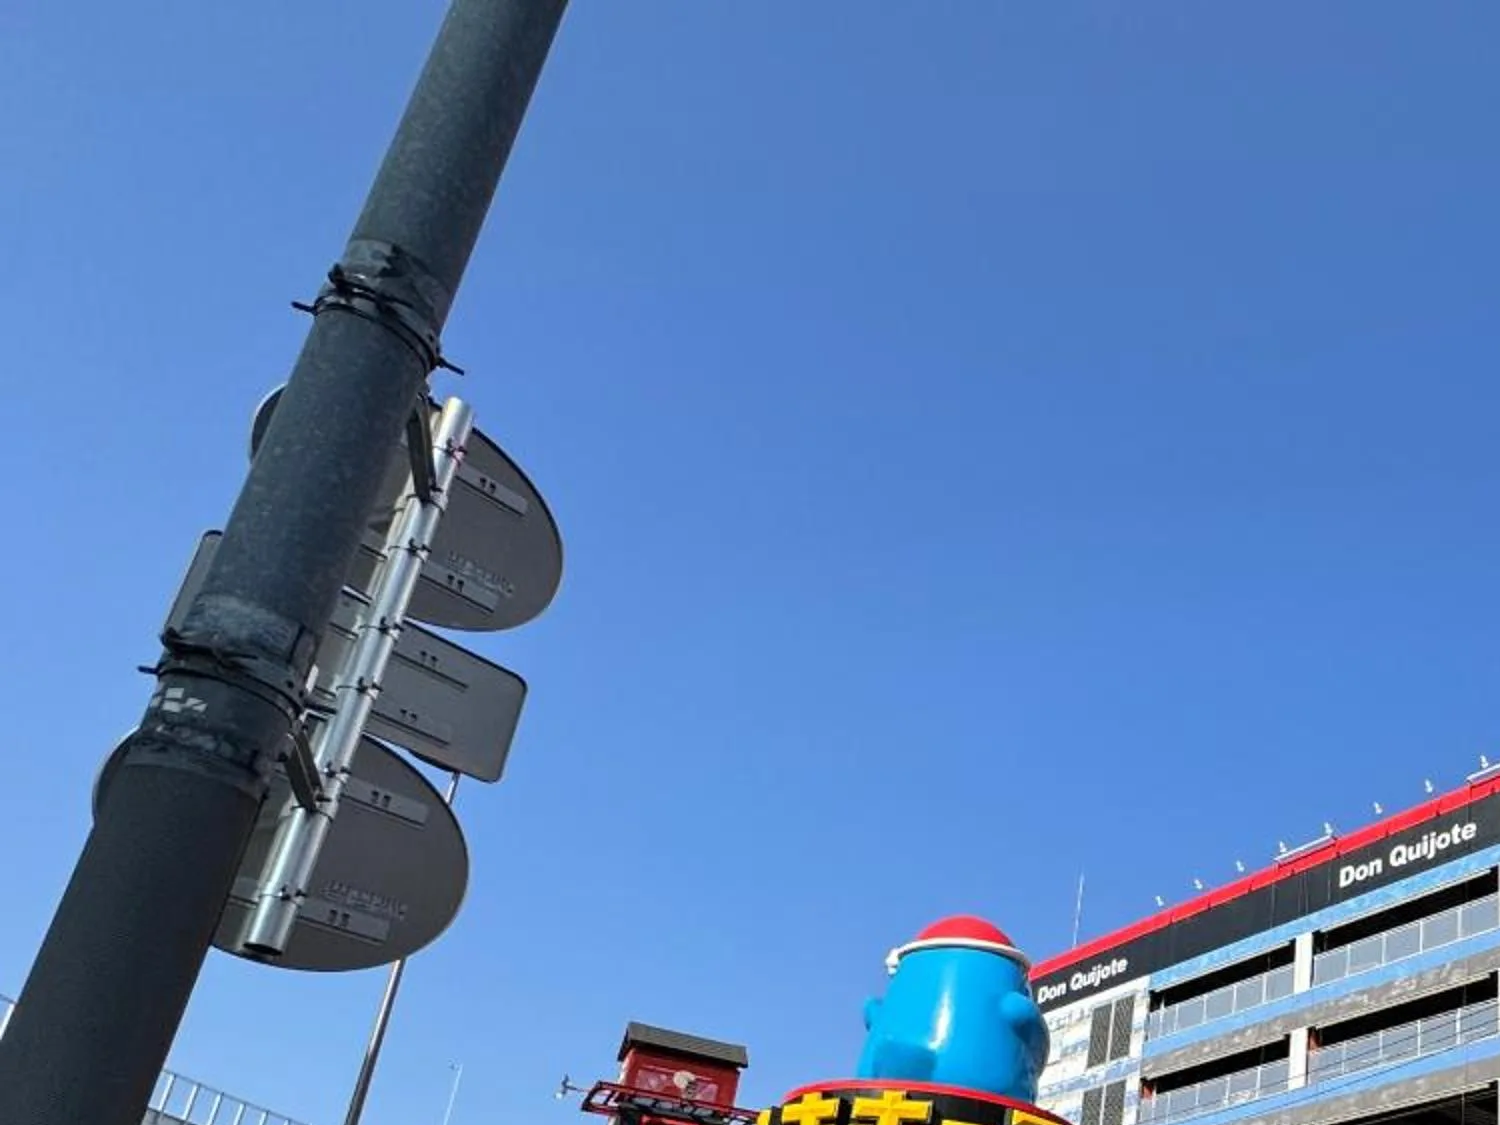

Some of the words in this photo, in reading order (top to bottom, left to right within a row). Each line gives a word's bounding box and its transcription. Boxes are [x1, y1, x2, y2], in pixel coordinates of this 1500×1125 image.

[1339, 858, 1383, 889] Don
[1389, 820, 1478, 868] Quijote
[1038, 983, 1066, 1004] Don
[1071, 956, 1128, 990] Quijote
